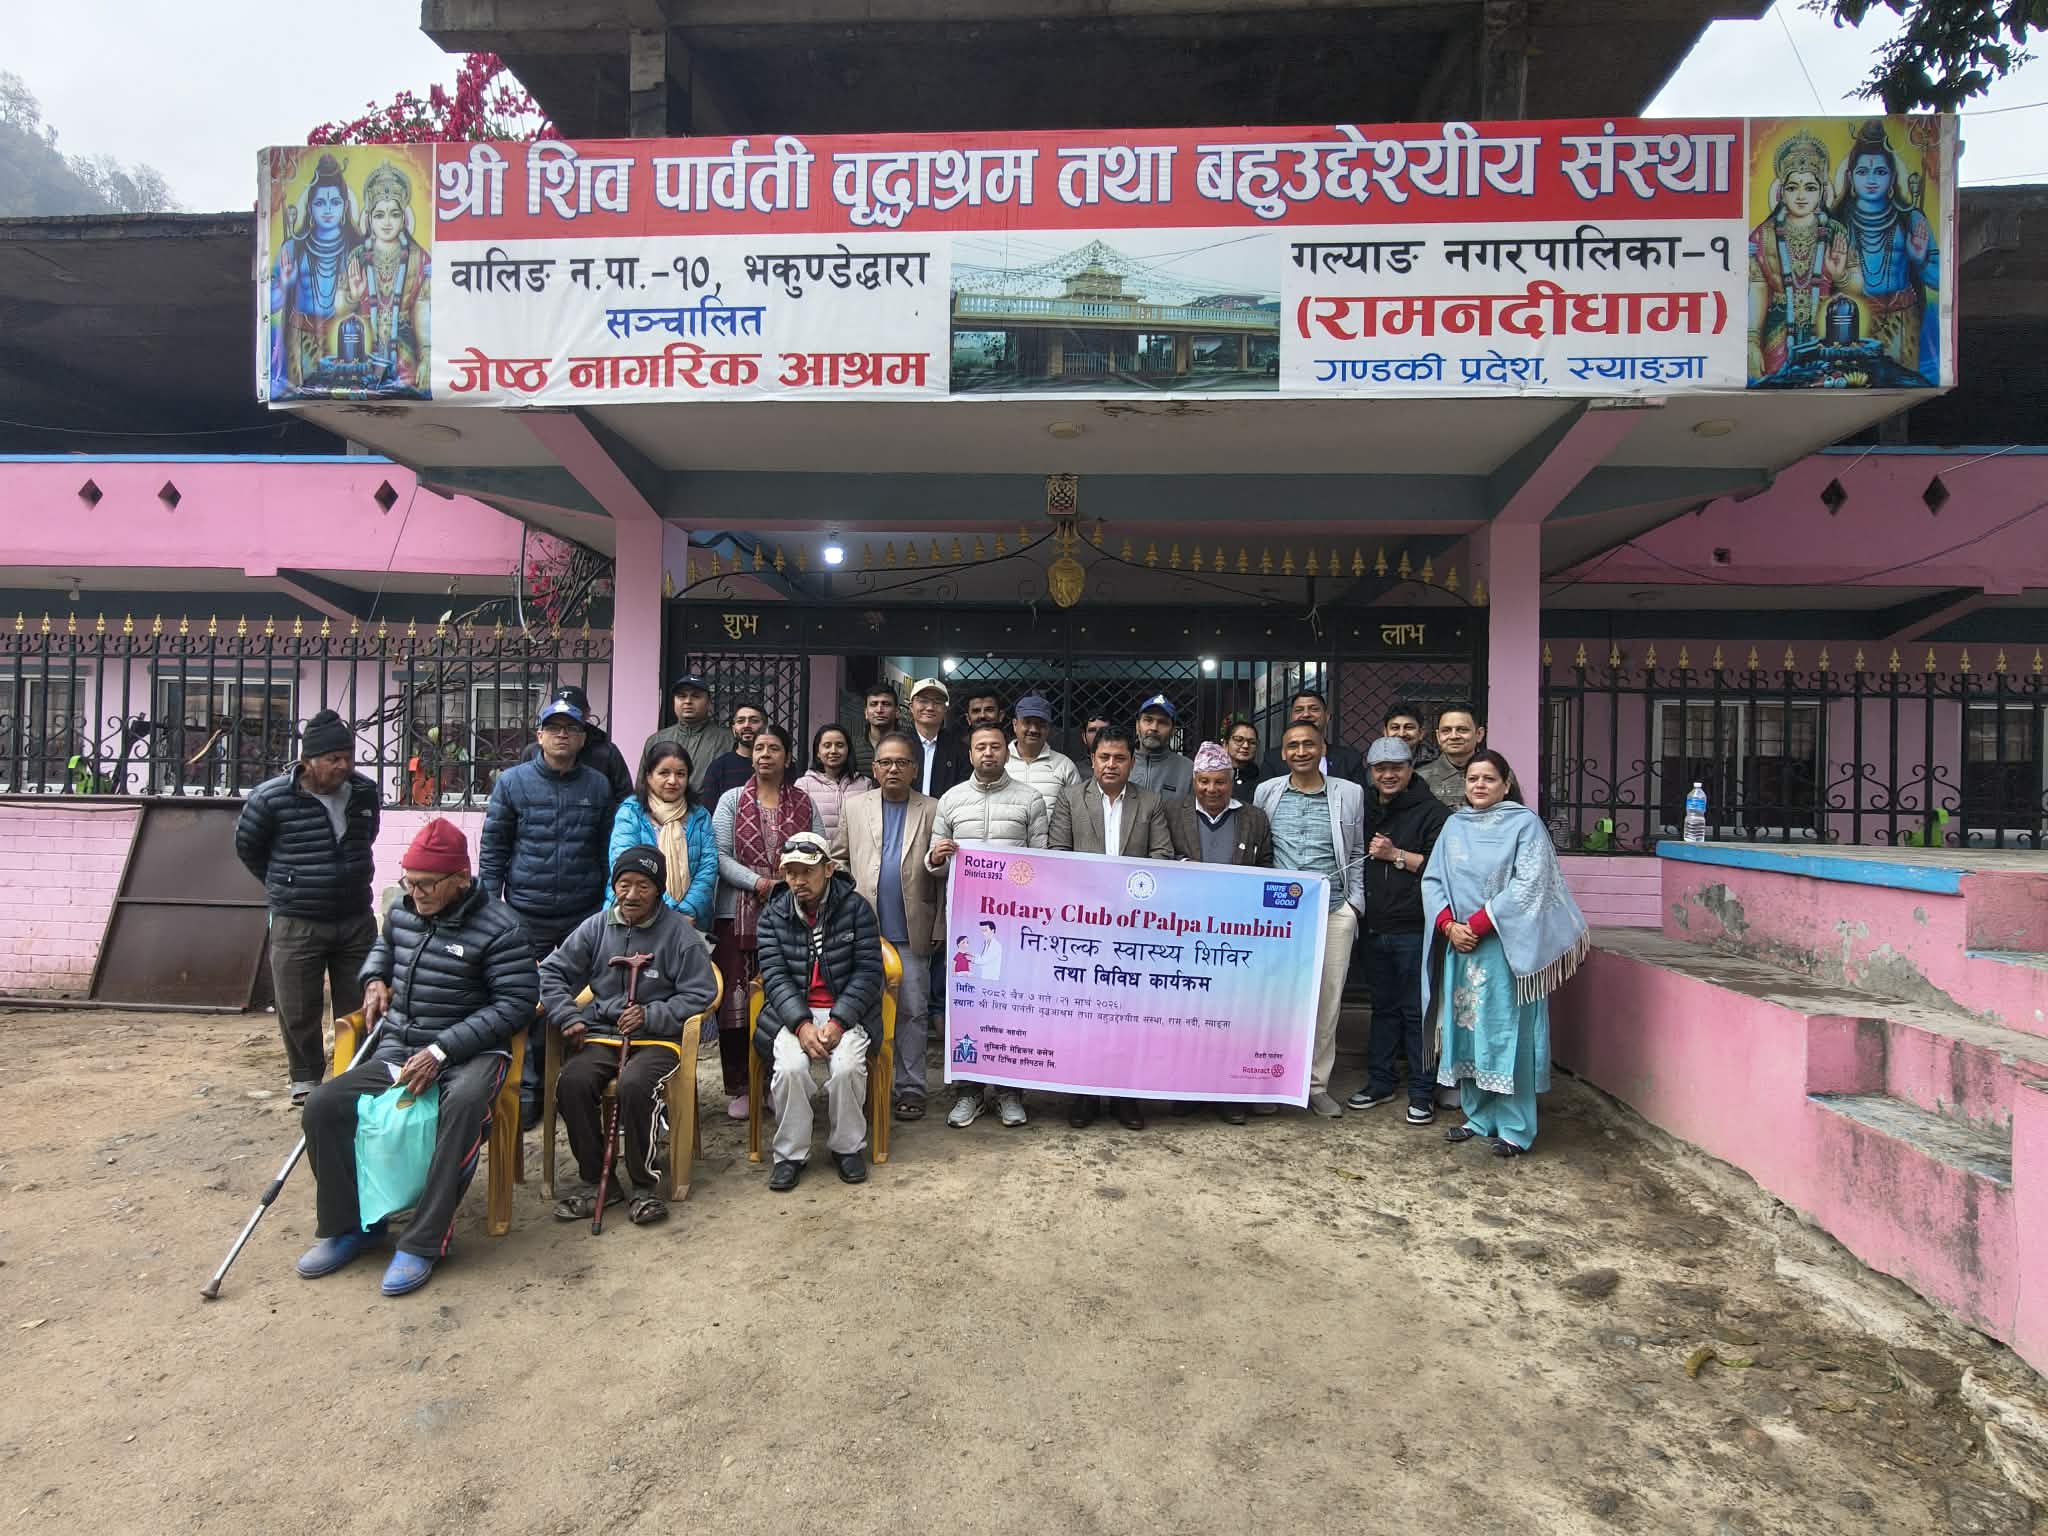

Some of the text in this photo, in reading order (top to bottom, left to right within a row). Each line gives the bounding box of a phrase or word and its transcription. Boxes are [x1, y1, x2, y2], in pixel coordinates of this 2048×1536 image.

[437, 141, 509, 220] श्री
[527, 138, 635, 220] शिव
[652, 134, 816, 217] पार्वती
[1057, 146, 1178, 208] तथा
[1561, 122, 1737, 200] संस्था
[1291, 224, 1732, 275] गल्याङ नगरपालिका-१
[451, 247, 556, 295] वालिङ
[606, 296, 767, 339] सञ्चालित
[1296, 279, 1728, 341] (रामनदीधाम)
[448, 343, 929, 393] जेष्ठ नागरिक आश्रम
[1315, 352, 1446, 383] गण्डकी
[1459, 351, 1549, 385] प्रदेश,
[721, 614, 760, 640] शुभ
[1380, 624, 1425, 645] लाभ
[965, 855, 1006, 871] Rotary
[979, 895, 1293, 939] Rotary Club of Palpa Lumbini
[1112, 941, 1184, 963] स्वास्थ्य
[1195, 940, 1253, 969] शिविर
[1053, 965, 1087, 984] तथा
[1149, 971, 1212, 993] कार्यक्रम
[1242, 1066, 1271, 1074] Rotaract
